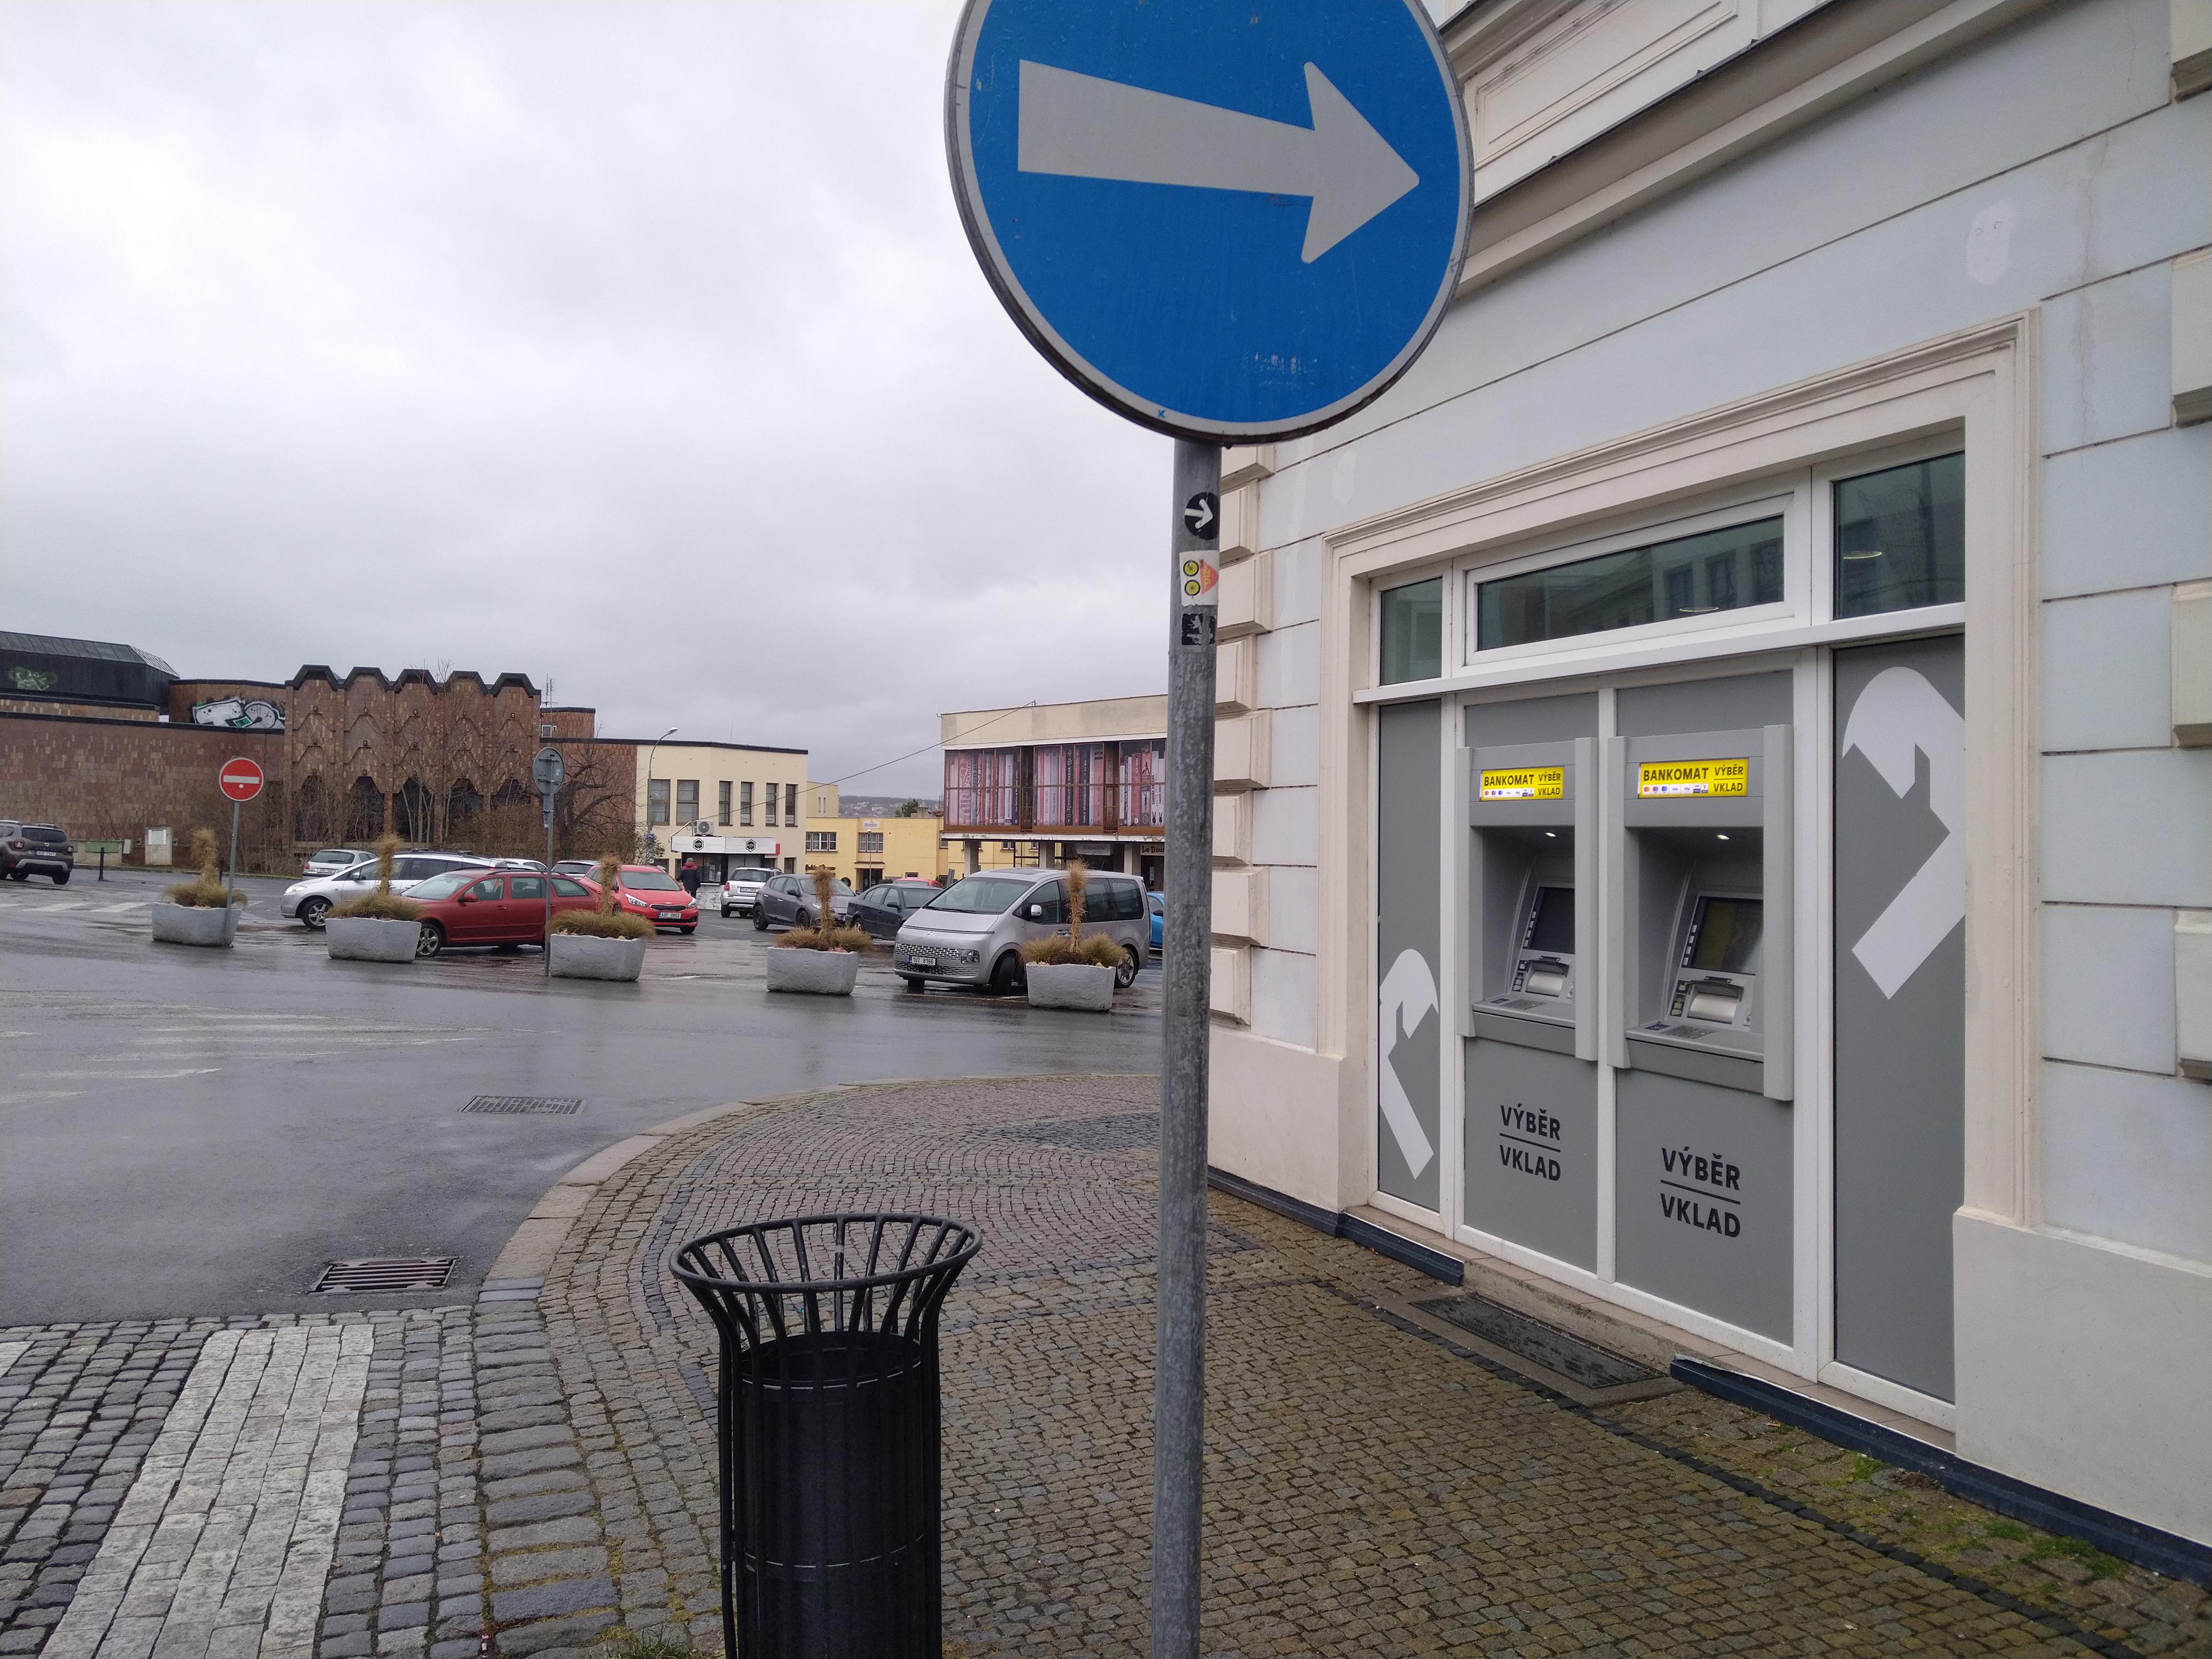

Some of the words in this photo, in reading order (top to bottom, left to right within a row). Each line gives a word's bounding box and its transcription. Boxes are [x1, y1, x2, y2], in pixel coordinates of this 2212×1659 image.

[1538, 771, 1561, 781] VÝBĚR
[1643, 767, 1709, 781] BANKOMAT
[1714, 764, 1743, 776] VÝBĚR
[1484, 774, 1534, 786] BANKOMAT
[1538, 787, 1561, 796] VKLAD
[1714, 782, 1743, 792] VKLAD
[1500, 1103, 1561, 1141] VÝBĚR
[1499, 1144, 1561, 1182] VKLAD
[1661, 1146, 1740, 1191] VÝBĚR
[1660, 1193, 1741, 1238] VKLAD
